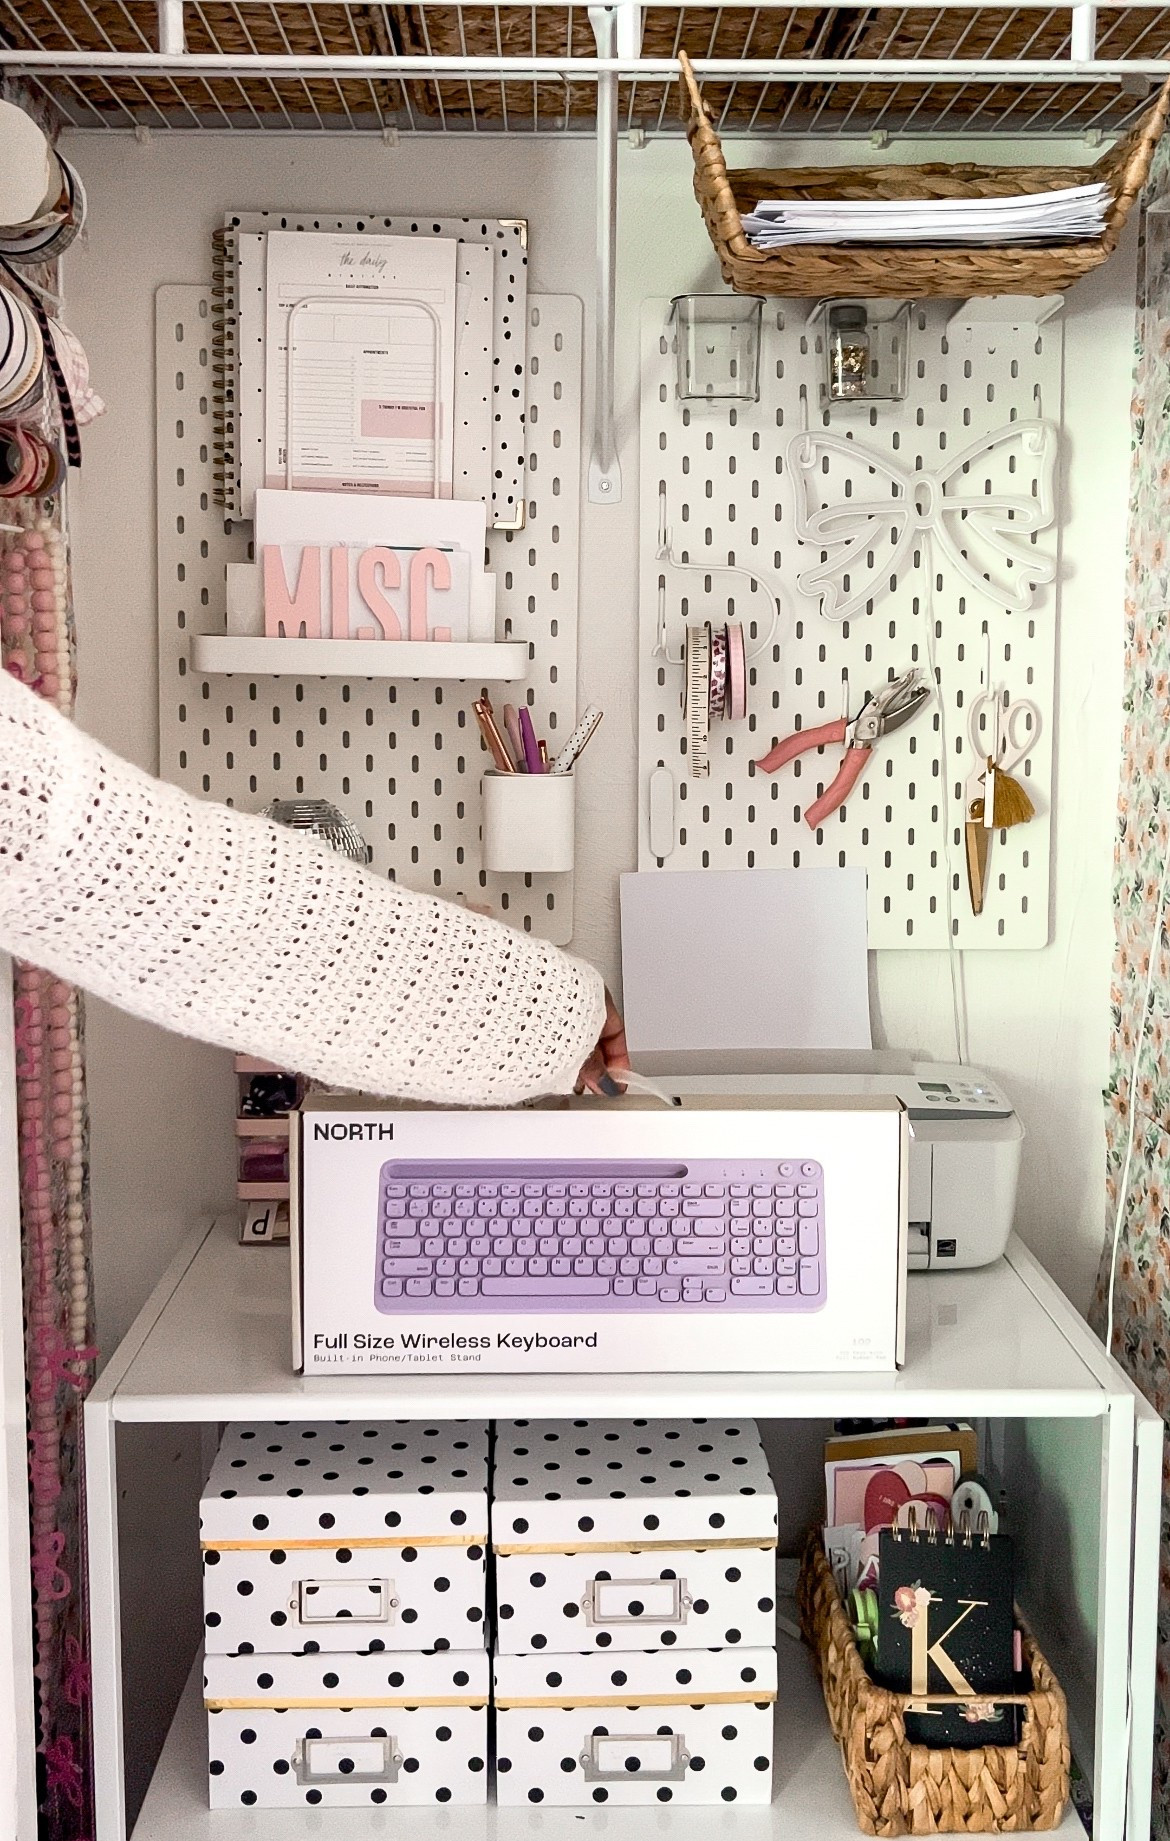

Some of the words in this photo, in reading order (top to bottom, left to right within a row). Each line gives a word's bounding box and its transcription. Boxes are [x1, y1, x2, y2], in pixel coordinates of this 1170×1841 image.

[340, 251, 355, 266] the
[359, 251, 388, 274] daily
[263, 544, 451, 642] MISC
[315, 1123, 393, 1140] NORTH
[314, 1334, 347, 1348] Full
[354, 1334, 394, 1348] Size
[401, 1333, 490, 1348] Wireless
[498, 1332, 597, 1352] Keyboard
[905, 1597, 989, 1716] K
